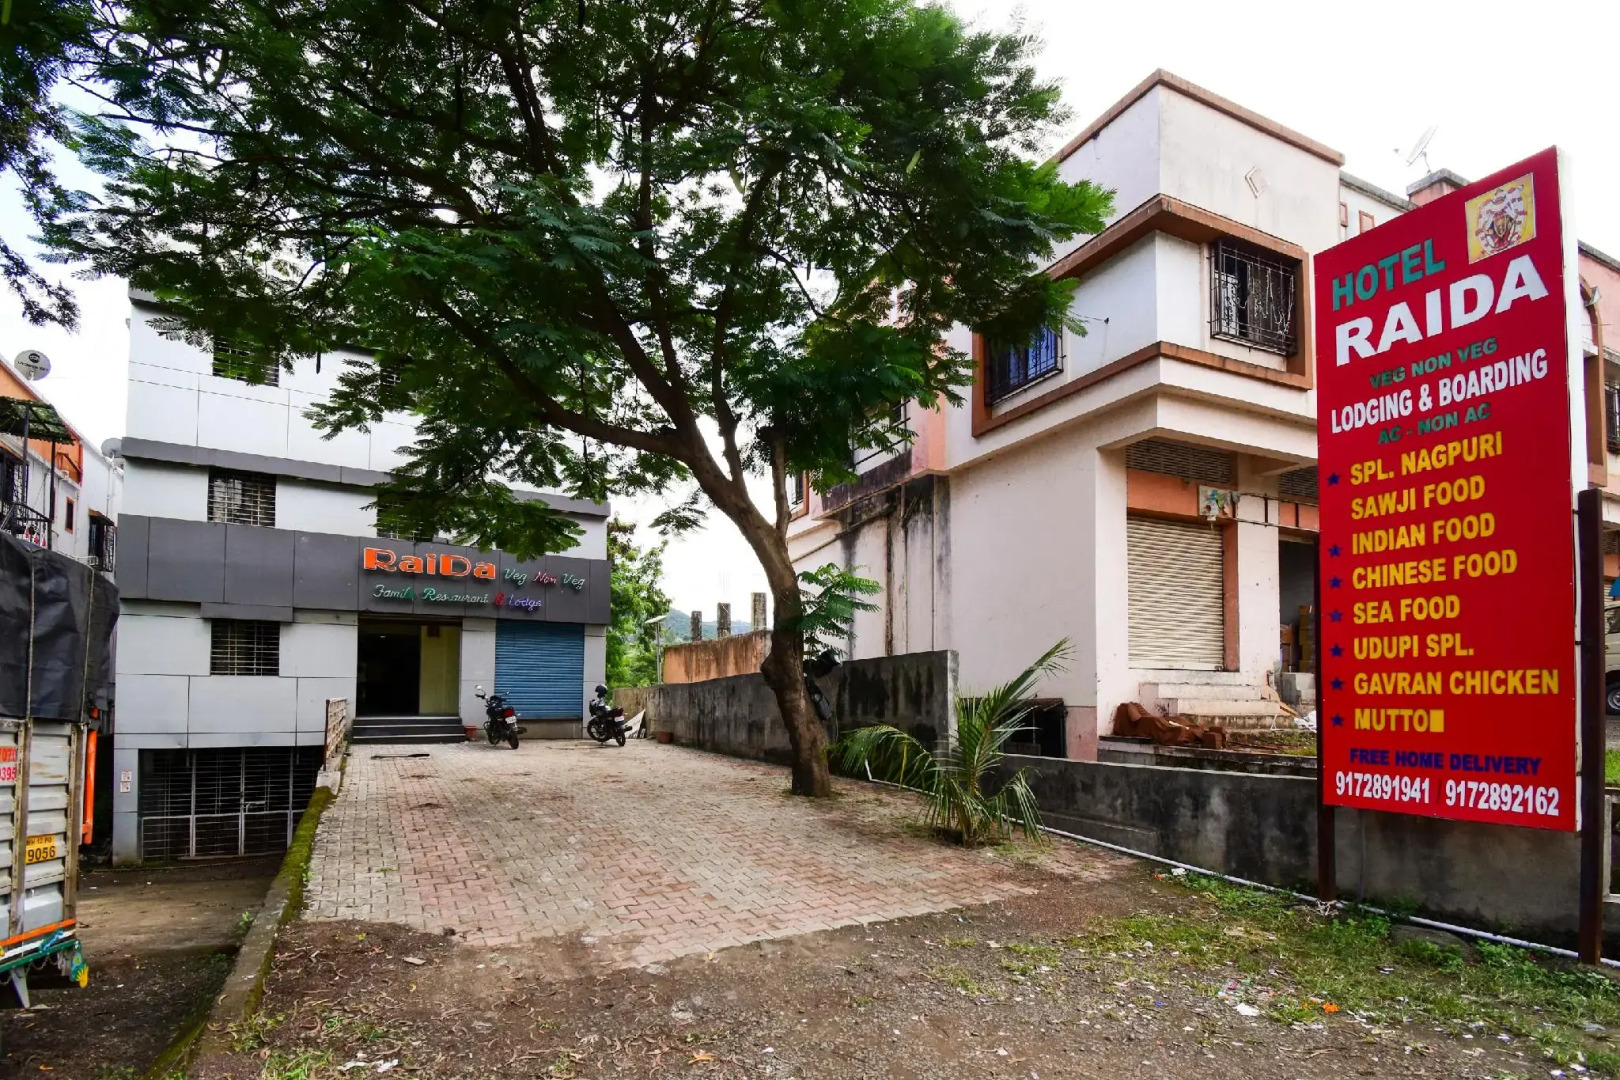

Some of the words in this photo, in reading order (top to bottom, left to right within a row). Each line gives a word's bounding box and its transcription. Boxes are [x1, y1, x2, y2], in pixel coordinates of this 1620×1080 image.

[1332, 238, 1445, 310] HOTEL
[1336, 254, 1549, 366] RAIDA
[1370, 366, 1406, 389] VEG
[1411, 352, 1452, 376] NON
[1458, 337, 1498, 362] VEG
[1331, 389, 1412, 434] LODGING
[1419, 384, 1432, 411] &
[1439, 348, 1548, 405] BOARDING
[1378, 422, 1402, 444] AC
[1418, 410, 1458, 435] NON
[1464, 403, 1492, 423] AC
[1350, 458, 1394, 485] SPL.
[1401, 431, 1502, 476] NAGPURI
[1352, 489, 1416, 520] SAWJI
[1424, 475, 1486, 507] FOOD
[1352, 524, 1425, 554] INDIAN
[1433, 512, 1495, 544] FOOD
[504, 568, 528, 586] Veg
[533, 572, 556, 584] Non
[563, 573, 586, 590] Veg
[1352, 558, 1446, 590] CHINESE
[1454, 549, 1518, 580] FOOD
[1353, 600, 1394, 624] SEA
[1400, 595, 1460, 621] FOOD
[1354, 635, 1418, 660] UDUPI
[1426, 633, 1474, 658] SPL.
[1354, 672, 1442, 695] GAVRAN
[1450, 669, 1559, 695] CHICKEN
[1354, 708, 1444, 732] MUTTO
[0, 766, 17, 780] 395
[1350, 748, 1390, 766] FREE
[1396, 750, 1444, 769] HOME
[1450, 753, 1542, 775] DELIVERY
[1336, 771, 1430, 804] 9172891941
[1446, 779, 1560, 816] 9172892162
[28, 846, 56, 862] 9056
